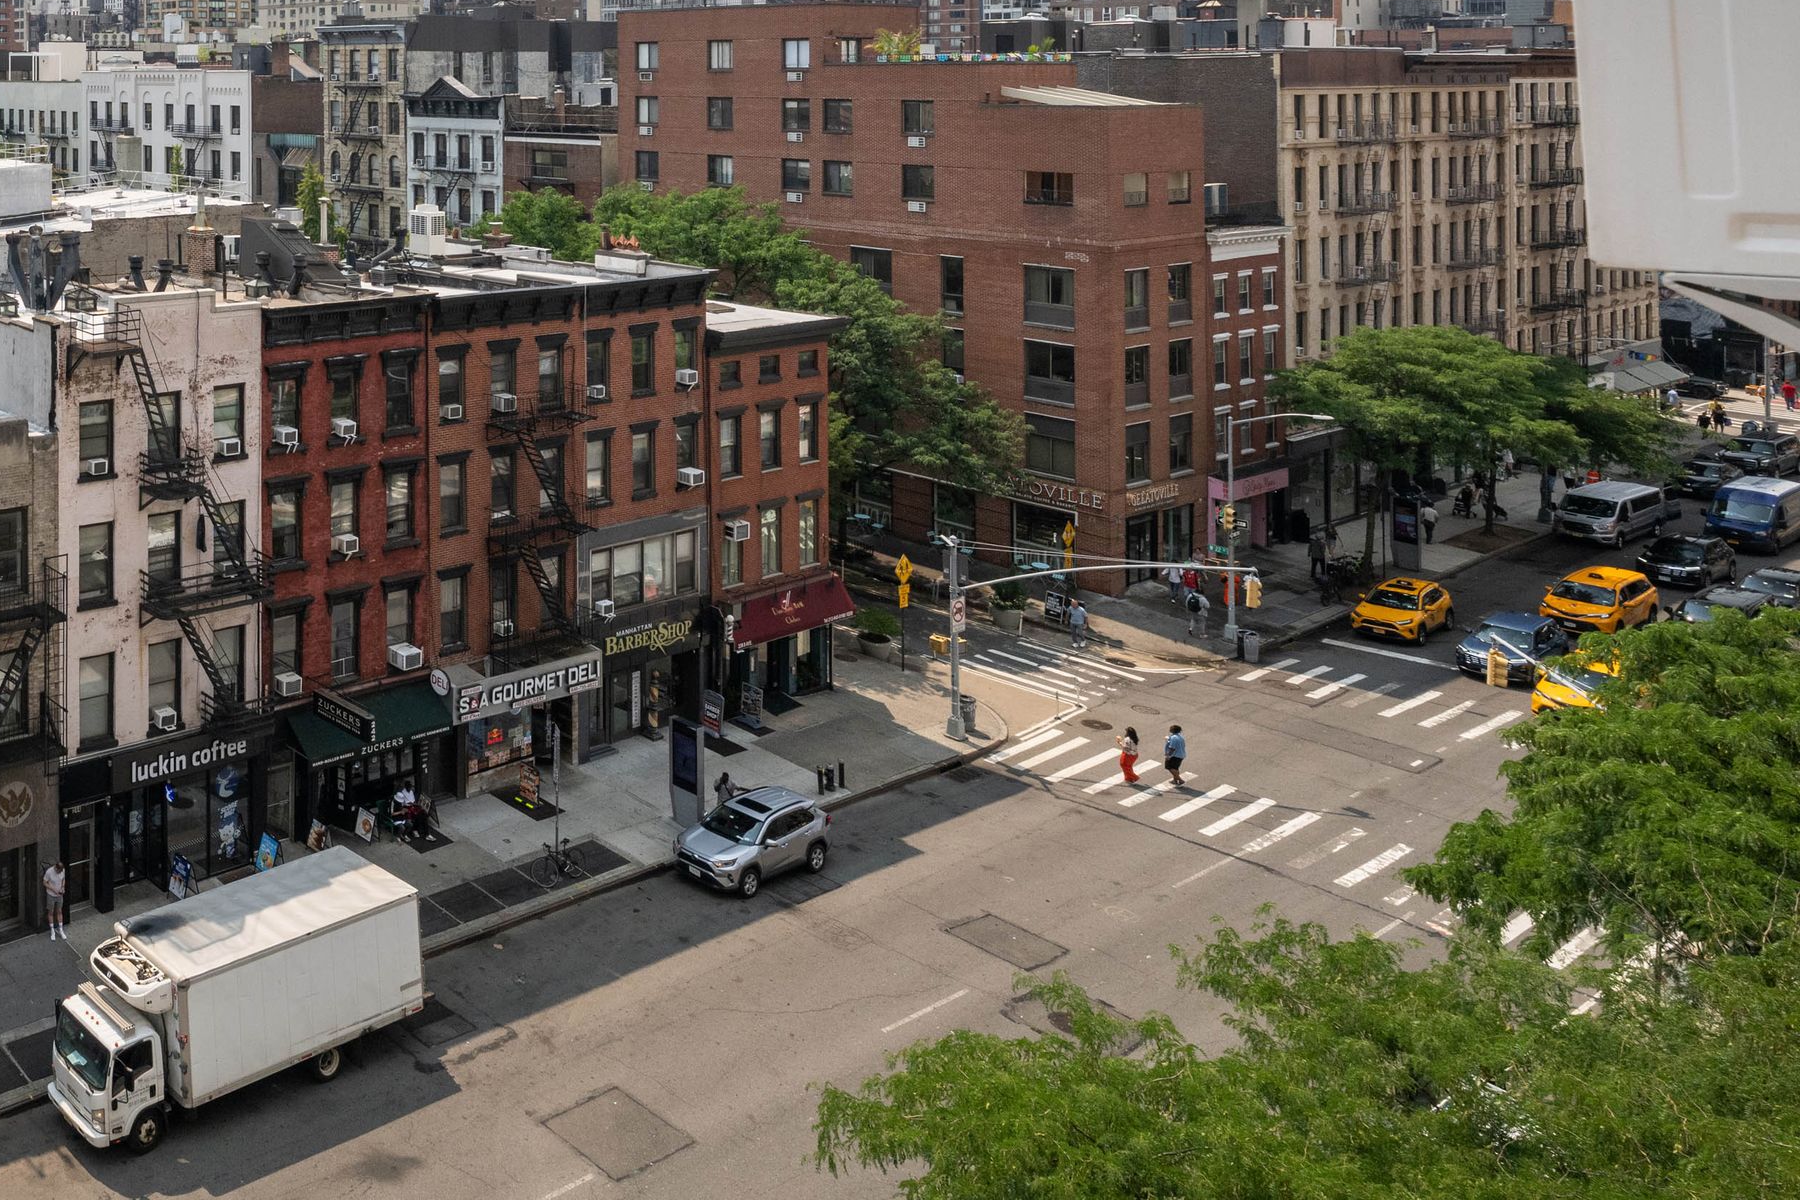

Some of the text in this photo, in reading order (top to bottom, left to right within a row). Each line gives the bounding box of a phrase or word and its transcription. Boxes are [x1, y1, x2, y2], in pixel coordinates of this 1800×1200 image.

[616, 623, 653, 637] MANHATTAN
[492, 670, 566, 705] GOURMET
[568, 660, 600, 685] DELI
[131, 739, 247, 783] luckin coffee
[361, 737, 404, 755] ZUCKER'S
